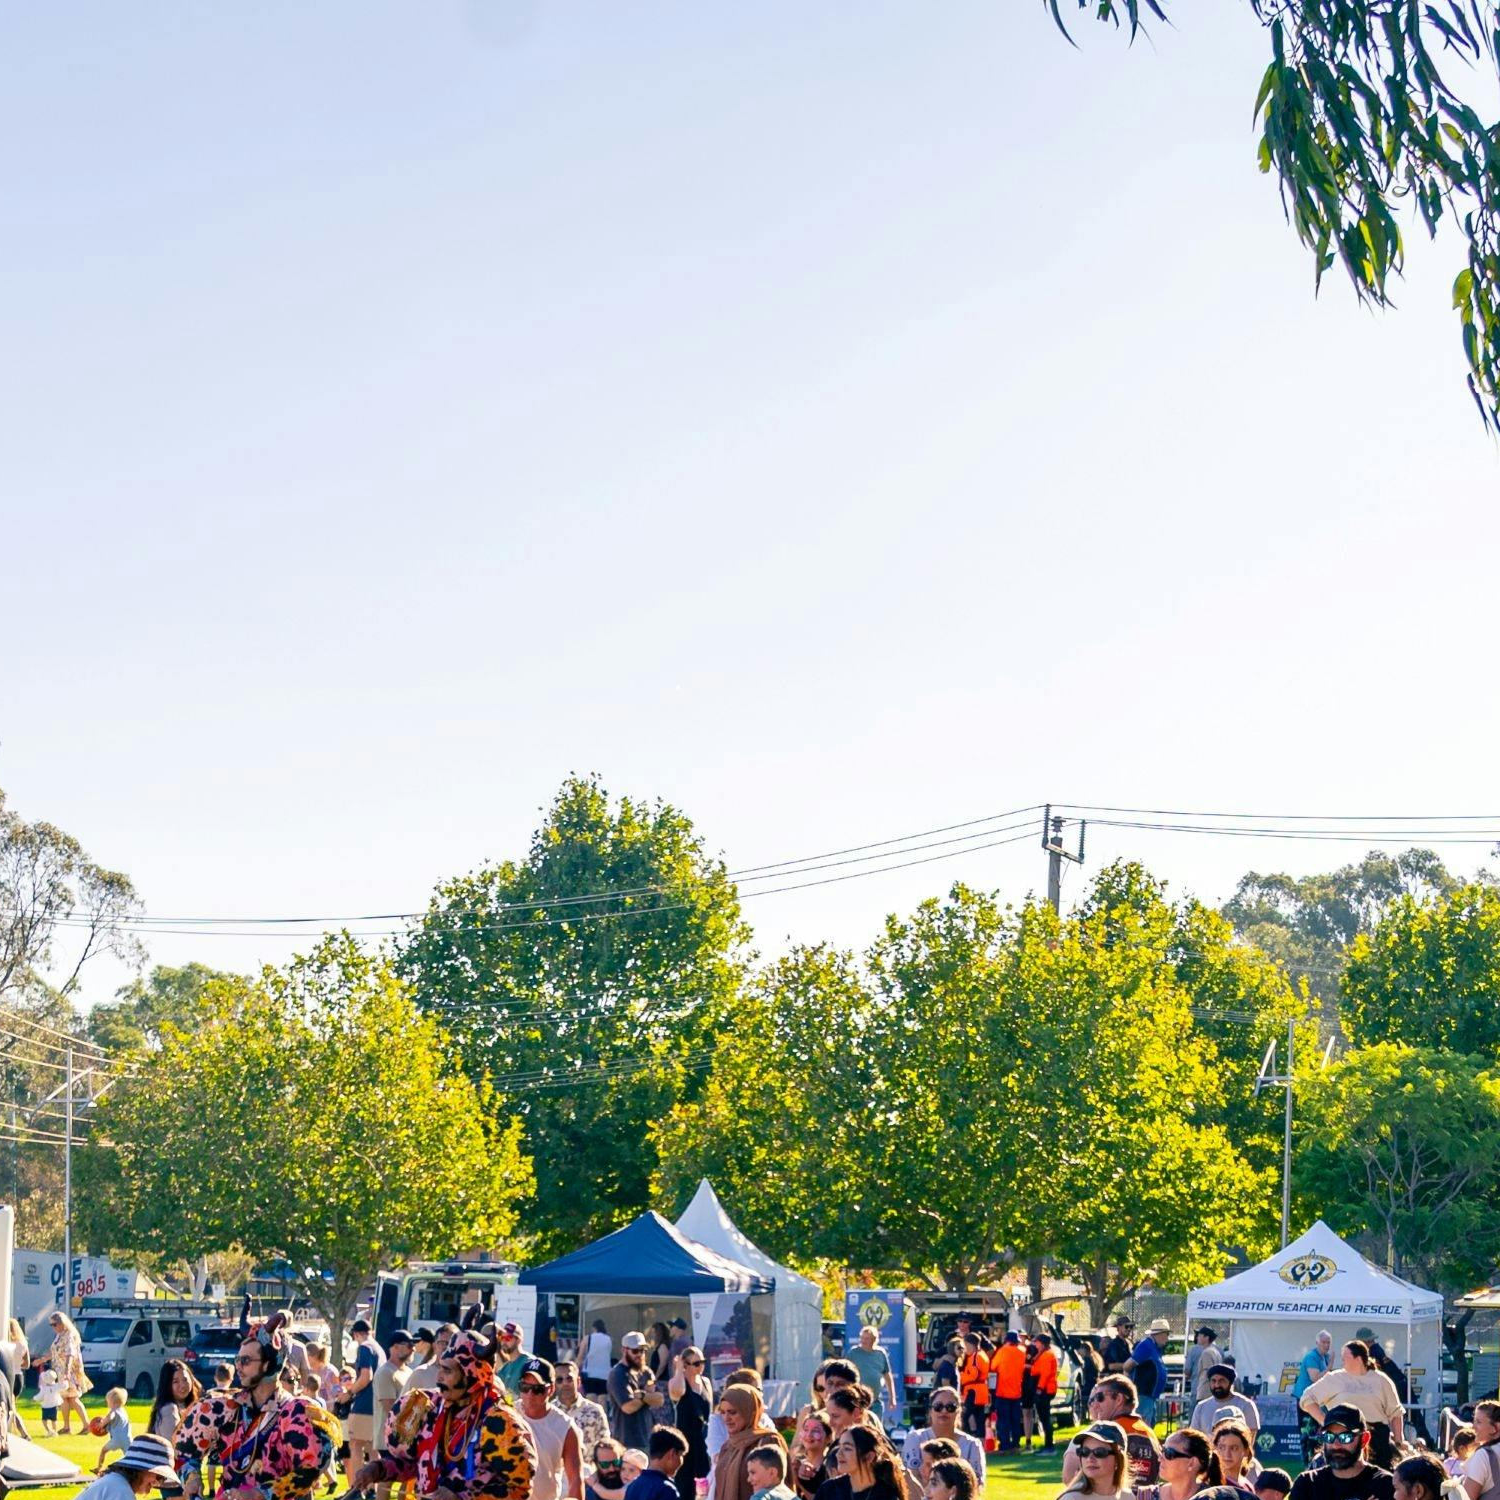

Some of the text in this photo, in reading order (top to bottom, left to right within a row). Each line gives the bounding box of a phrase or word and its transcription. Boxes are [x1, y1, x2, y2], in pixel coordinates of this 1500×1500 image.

[77, 1275, 106, 1298] 98.5
[1197, 1301, 1273, 1312] SHEPPARTON
[1277, 1303, 1322, 1314] SEARCH
[1326, 1304, 1352, 1315] AND
[1355, 1305, 1403, 1315] RESCUE
